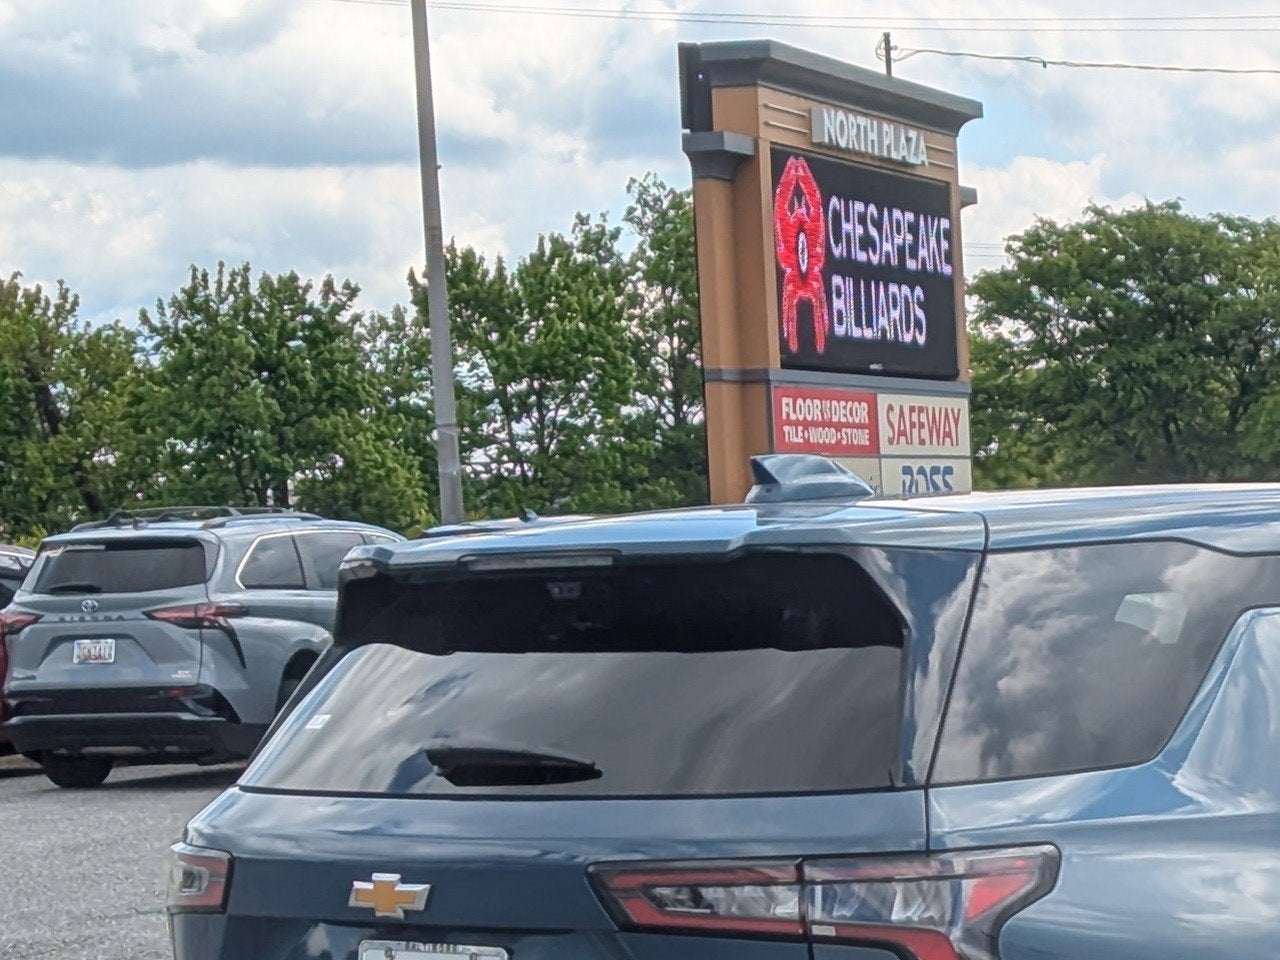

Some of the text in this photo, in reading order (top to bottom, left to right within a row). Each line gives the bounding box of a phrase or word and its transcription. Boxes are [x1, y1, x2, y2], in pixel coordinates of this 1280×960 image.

[822, 109, 929, 167] NORTH PLAZA
[828, 195, 953, 276] CHESAPEAKE
[831, 274, 927, 346] BILLIARDS
[781, 397, 822, 421] FLOOR
[831, 400, 869, 424] DECOR
[783, 425, 870, 446] TILE WOOD STONE
[886, 403, 961, 447] SAFEWAY
